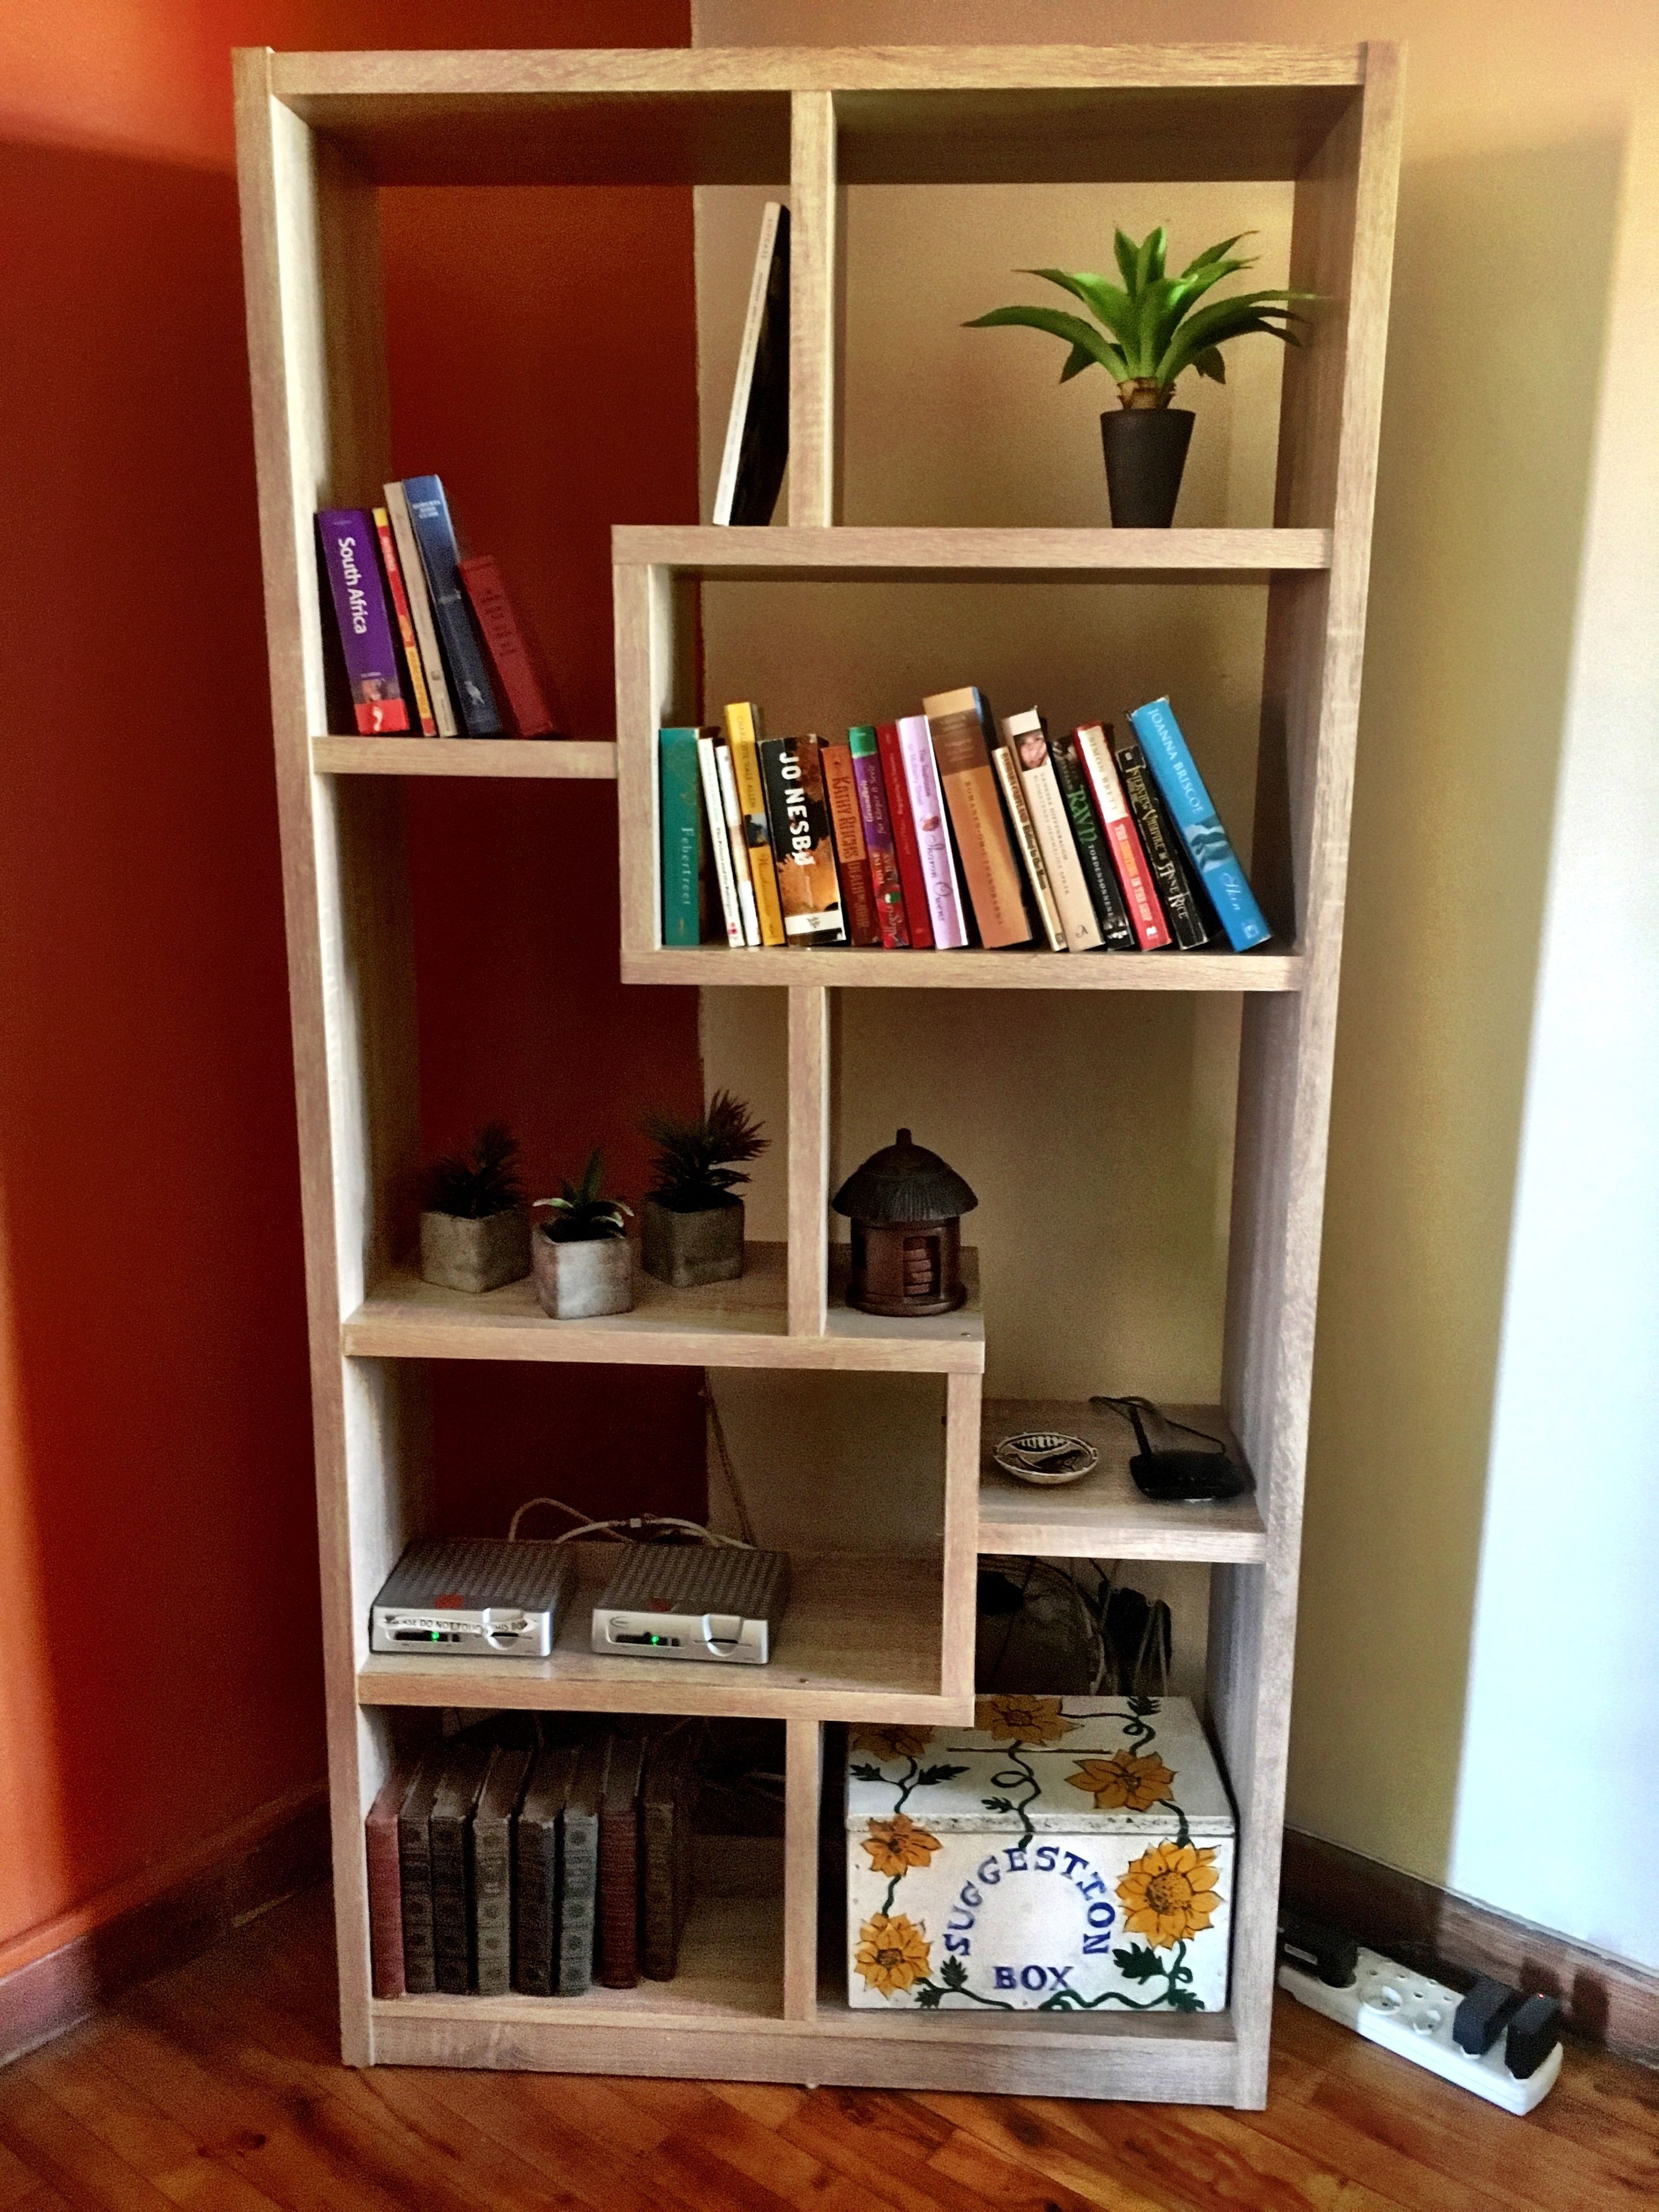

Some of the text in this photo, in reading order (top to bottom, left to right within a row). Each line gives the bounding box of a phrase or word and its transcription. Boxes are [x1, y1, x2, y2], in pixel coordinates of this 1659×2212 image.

[337, 535, 371, 635] South Africa
[743, 761, 753, 781] VALE
[1039, 772, 1054, 806] VANESSA
[1148, 707, 1203, 815] JOANNA BRISCOE
[746, 783, 757, 808] ALLEN
[778, 749, 817, 869] JO NESBØ
[832, 776, 861, 859] KATHY REICHS
[923, 832, 958, 922] Sharon Owens
[1156, 861, 1191, 919] ANNE RICE
[1218, 869, 1247, 912] Skin
[436, 1620, 454, 1630] NOT
[942, 1846, 1116, 1956] SUGGESTION
[993, 1965, 1075, 1991] BOX
